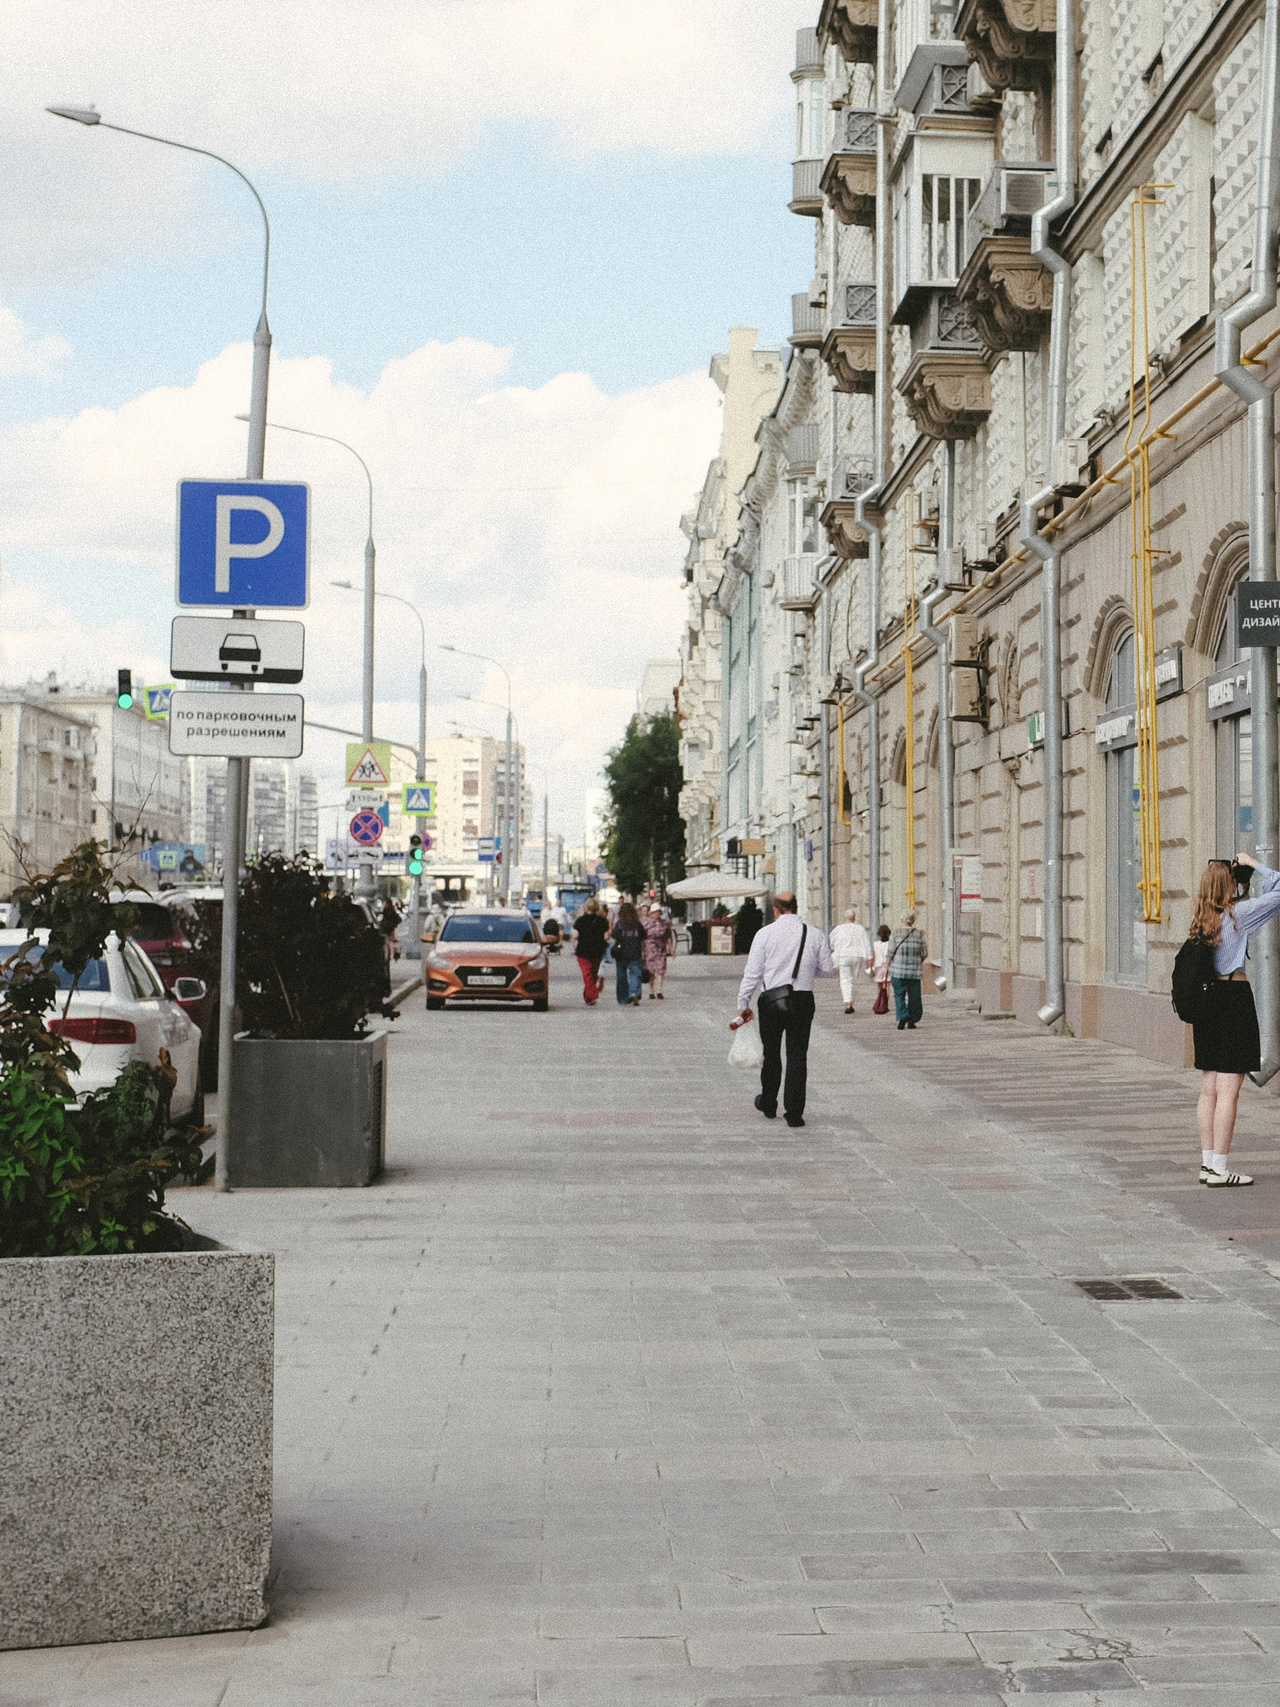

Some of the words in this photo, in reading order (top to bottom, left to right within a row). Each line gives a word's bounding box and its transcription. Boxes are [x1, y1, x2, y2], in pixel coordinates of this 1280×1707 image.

[215, 494, 285, 593] P
[176, 711, 194, 720] по
[196, 711, 297, 723] парковочным
[186, 726, 286, 738] разрешениям
